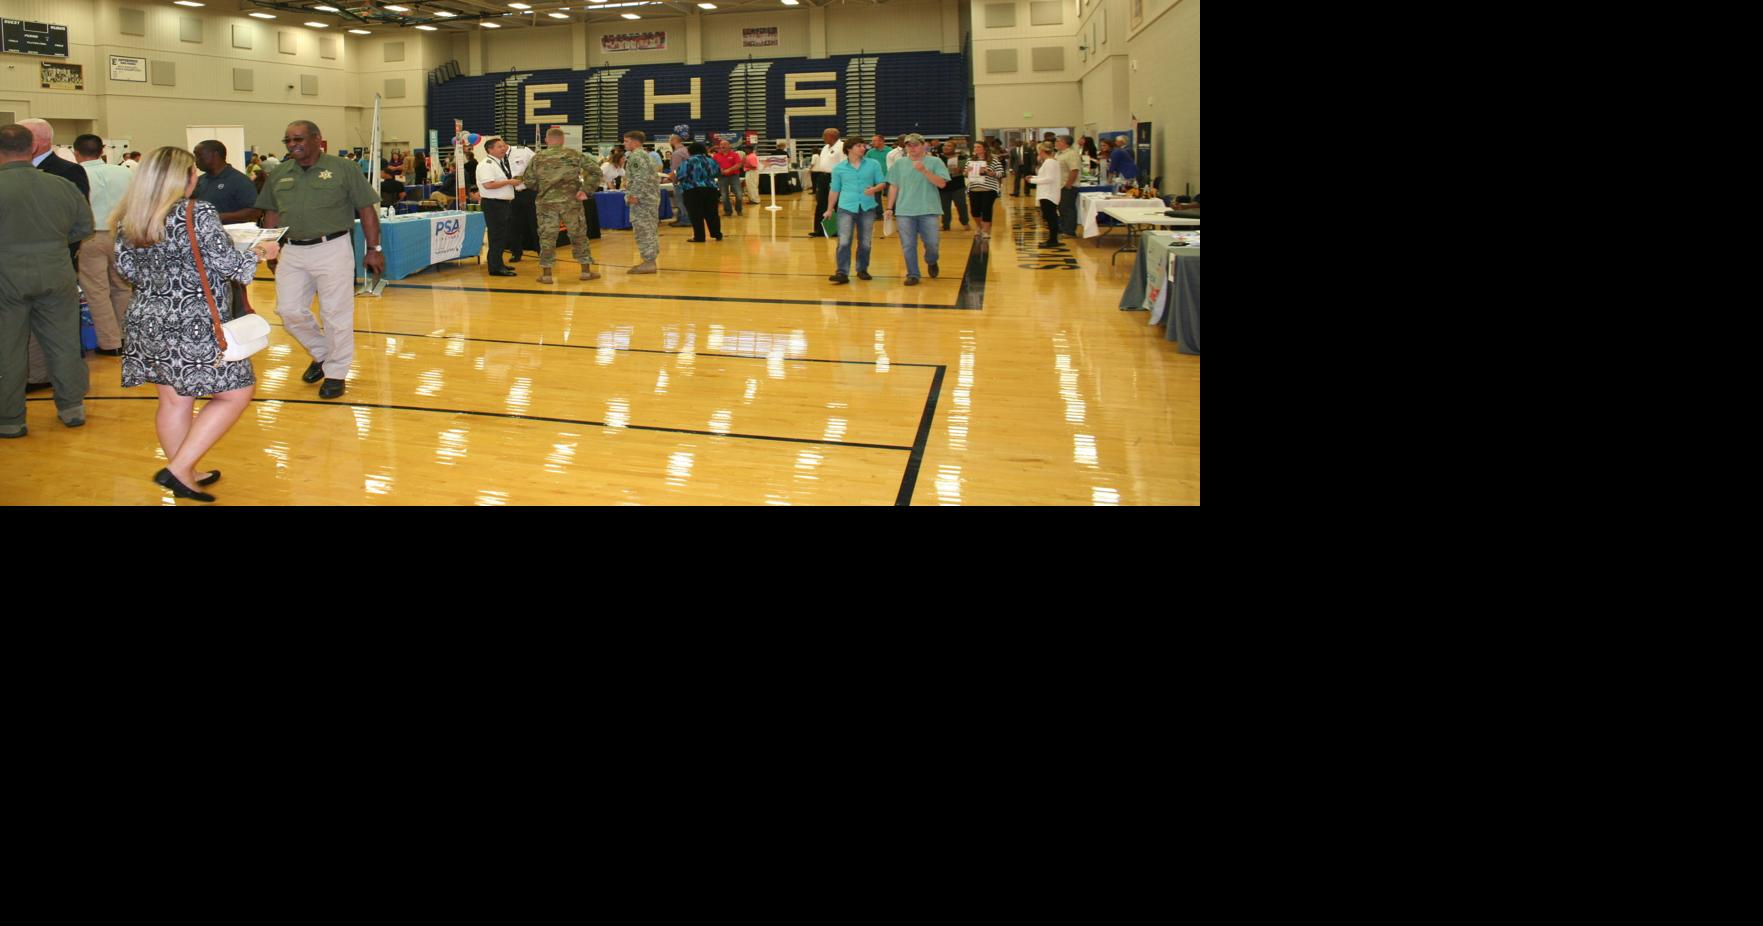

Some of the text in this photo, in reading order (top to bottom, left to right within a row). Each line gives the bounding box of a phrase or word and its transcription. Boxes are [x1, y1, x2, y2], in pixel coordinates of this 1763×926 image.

[525, 72, 837, 124] E H S
[435, 219, 460, 236] PSA
